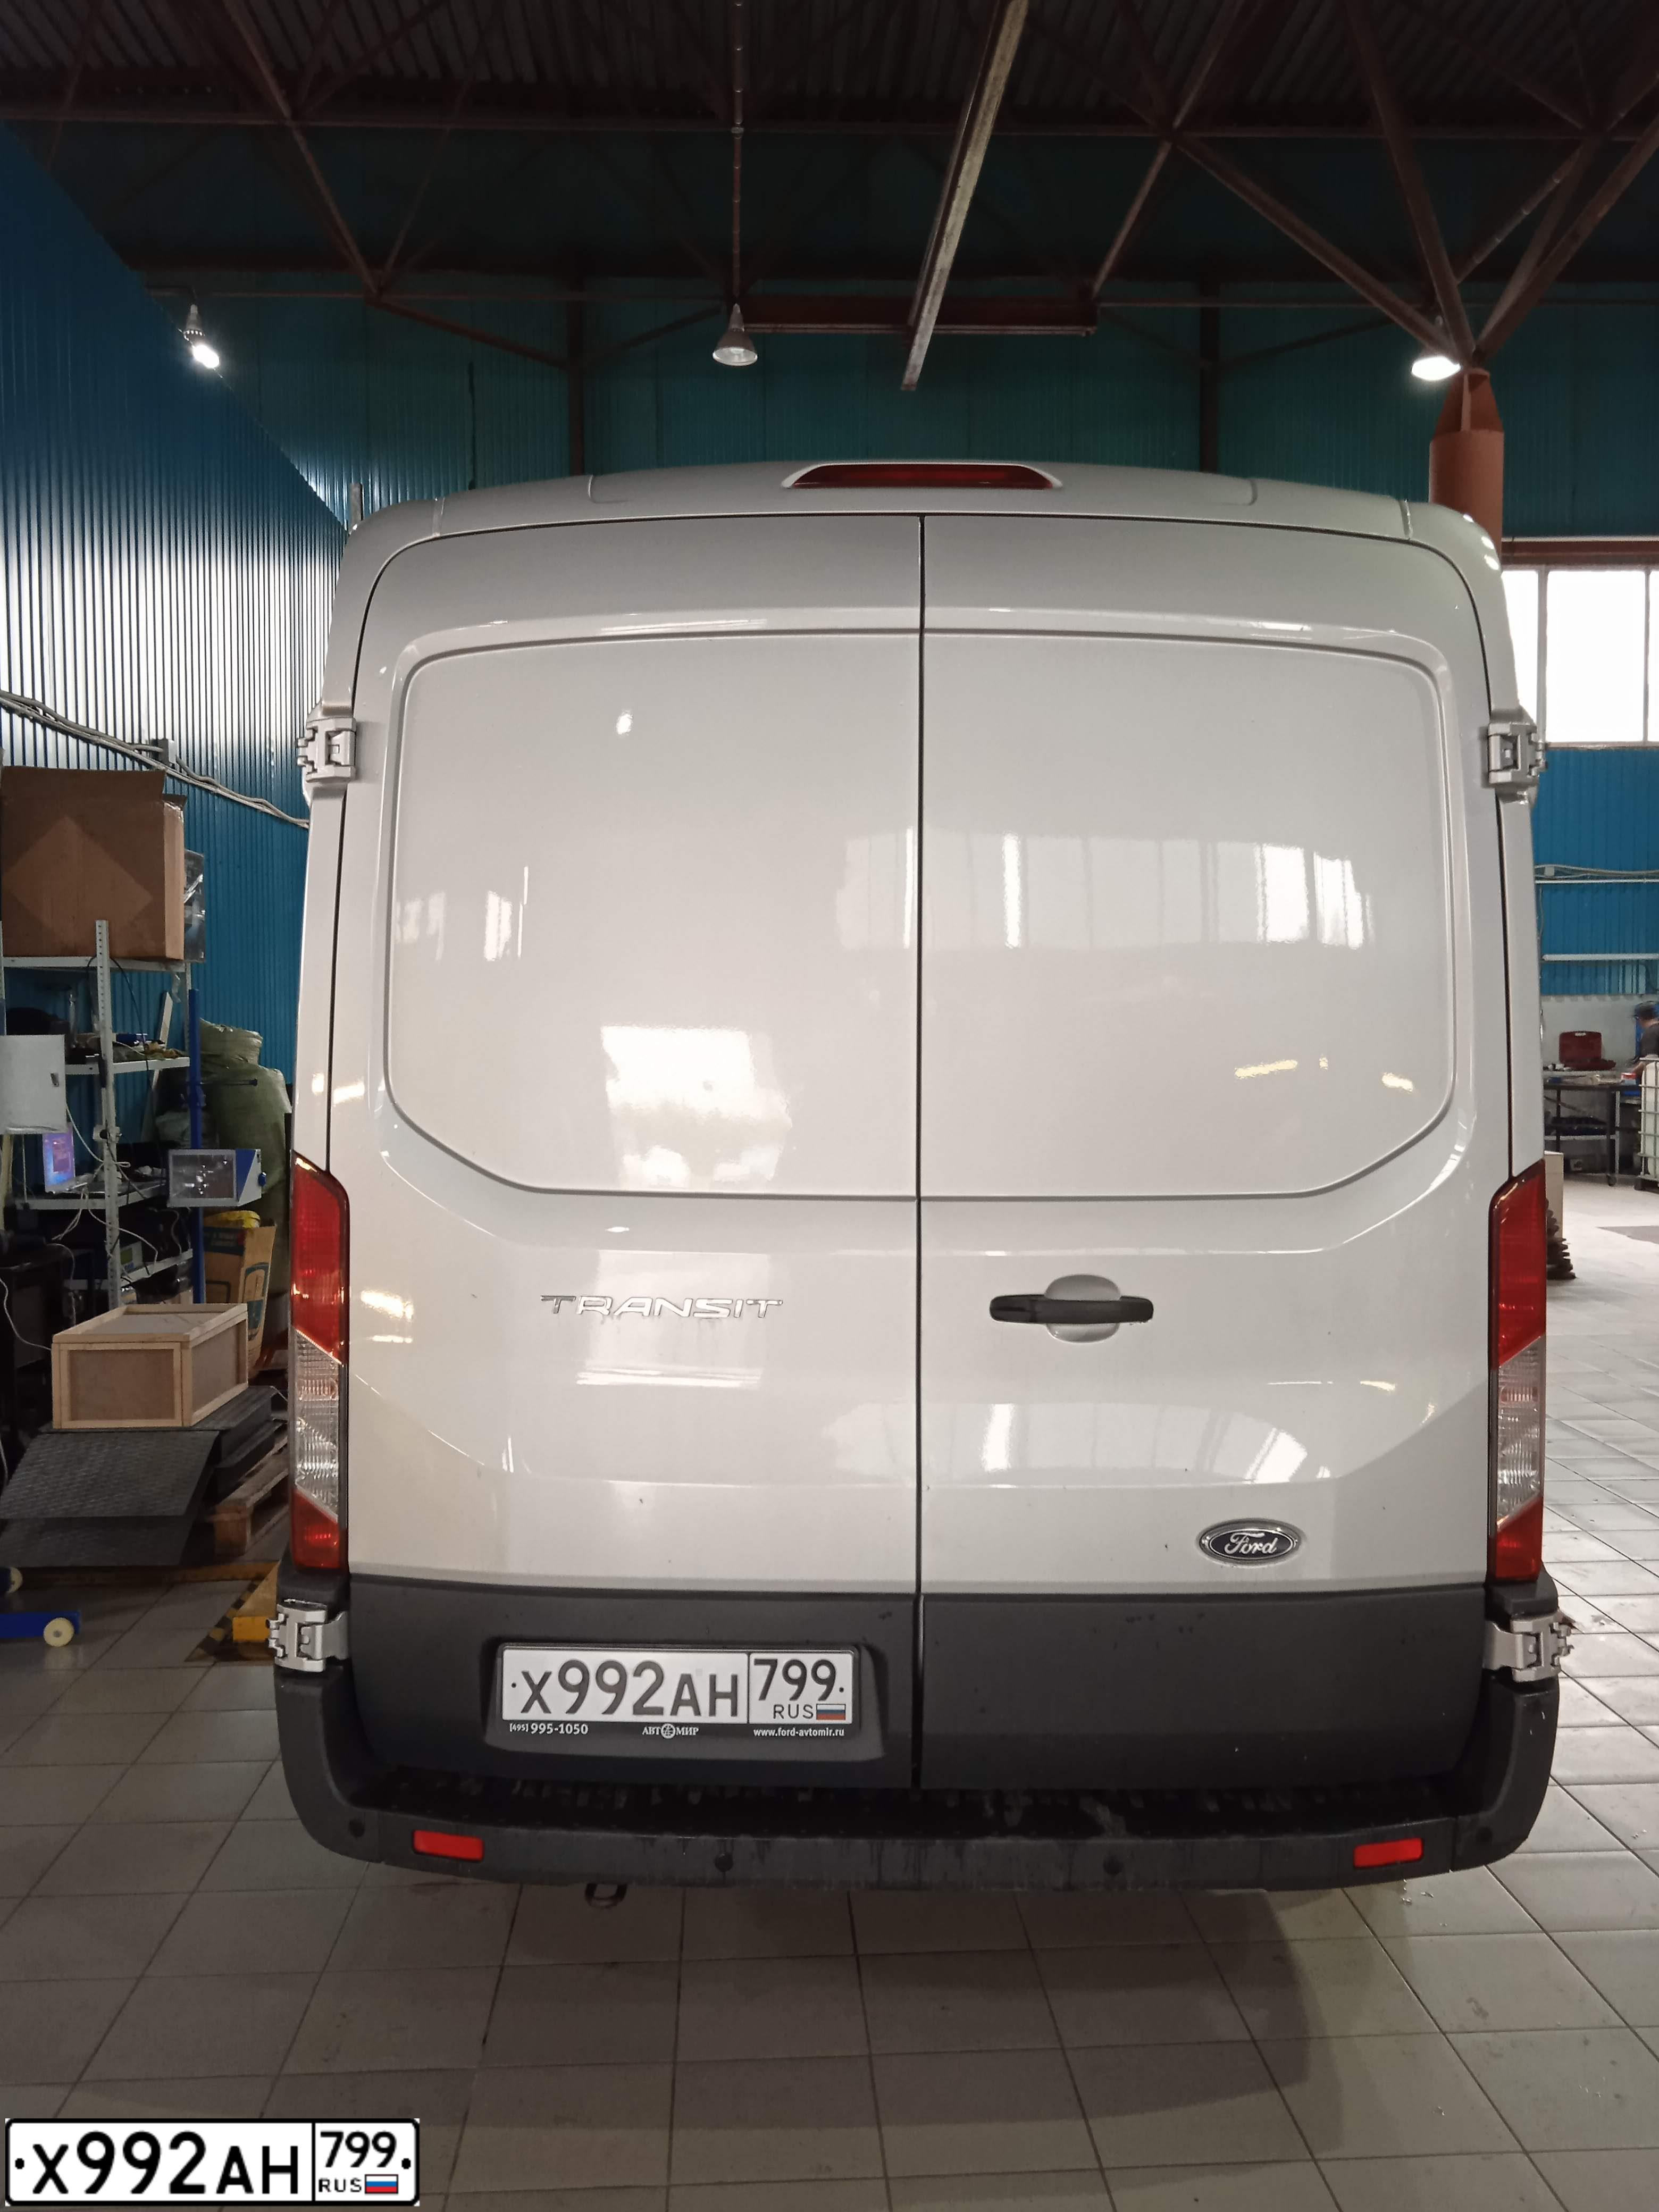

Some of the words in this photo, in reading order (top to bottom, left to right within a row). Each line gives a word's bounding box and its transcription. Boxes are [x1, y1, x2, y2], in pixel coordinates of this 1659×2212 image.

[540, 1295, 783, 1319] TRANSIT
[1224, 1532, 1278, 1554] Ford
[753, 1658, 836, 1702] 799
[773, 1705, 814, 1719] RUS
[531, 1723, 589, 1735] 995-1050
[753, 1727, 845, 1738] www.ford-avtomir.ru
